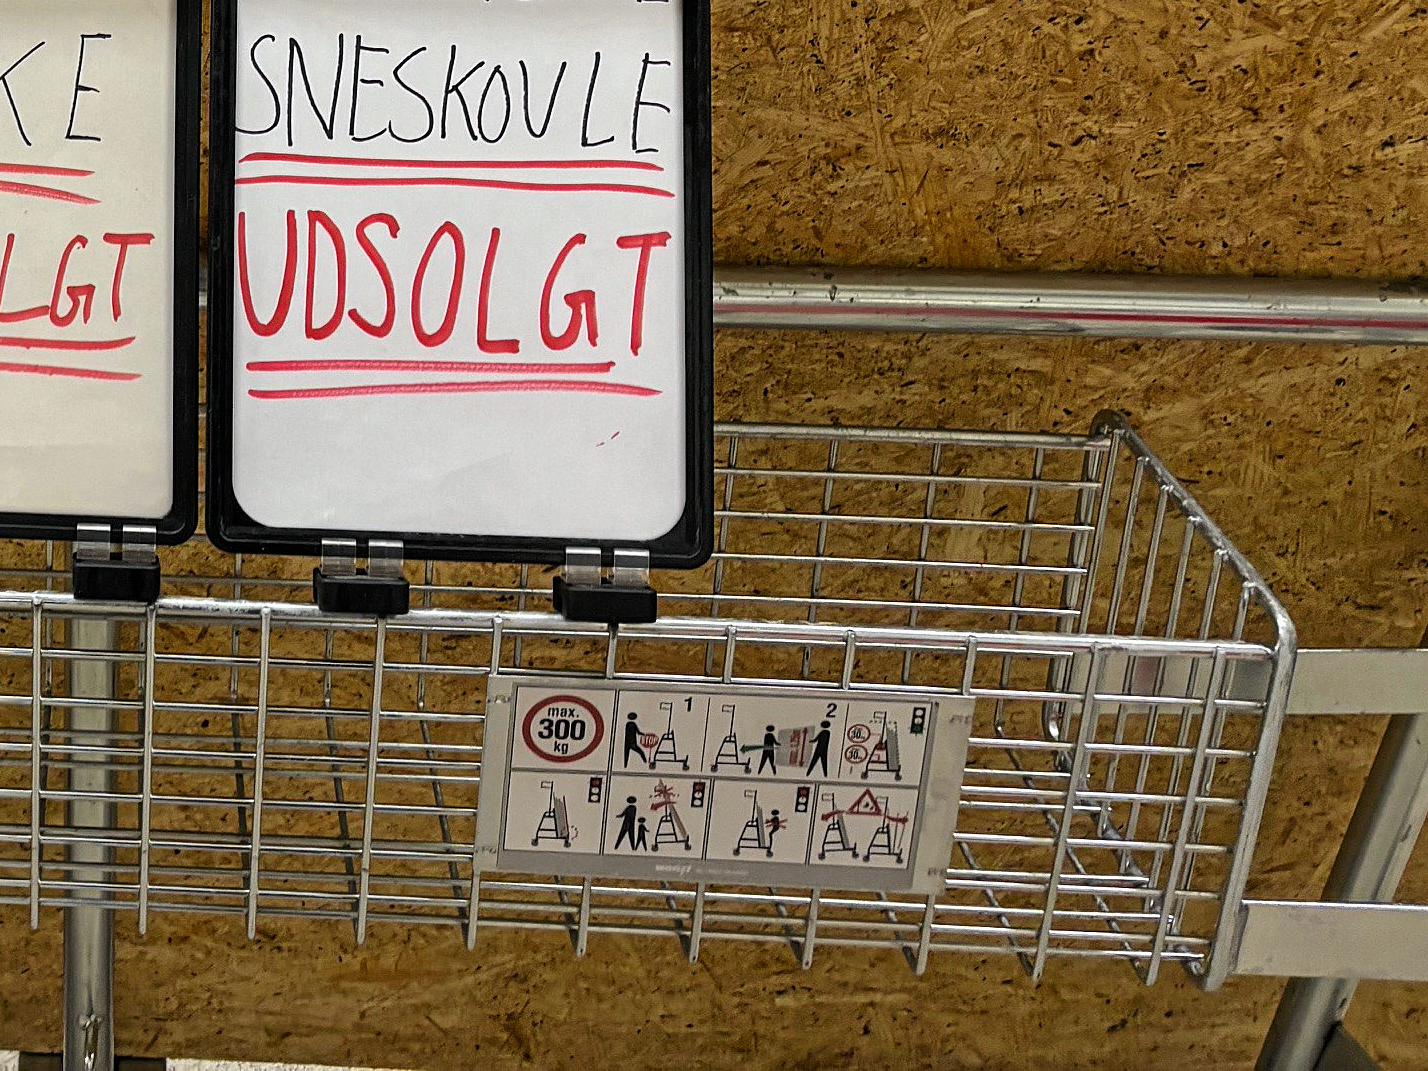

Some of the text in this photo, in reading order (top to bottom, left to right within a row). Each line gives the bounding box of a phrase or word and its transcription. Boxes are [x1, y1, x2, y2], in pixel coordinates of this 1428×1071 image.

[235, 32, 672, 154] SNESKOVLE
[237, 208, 673, 357] UDSOLGT
[547, 707, 580, 719] max.
[684, 697, 693, 713] 1
[825, 702, 838, 718] 2
[538, 718, 586, 741] 300
[554, 740, 569, 755] kg
